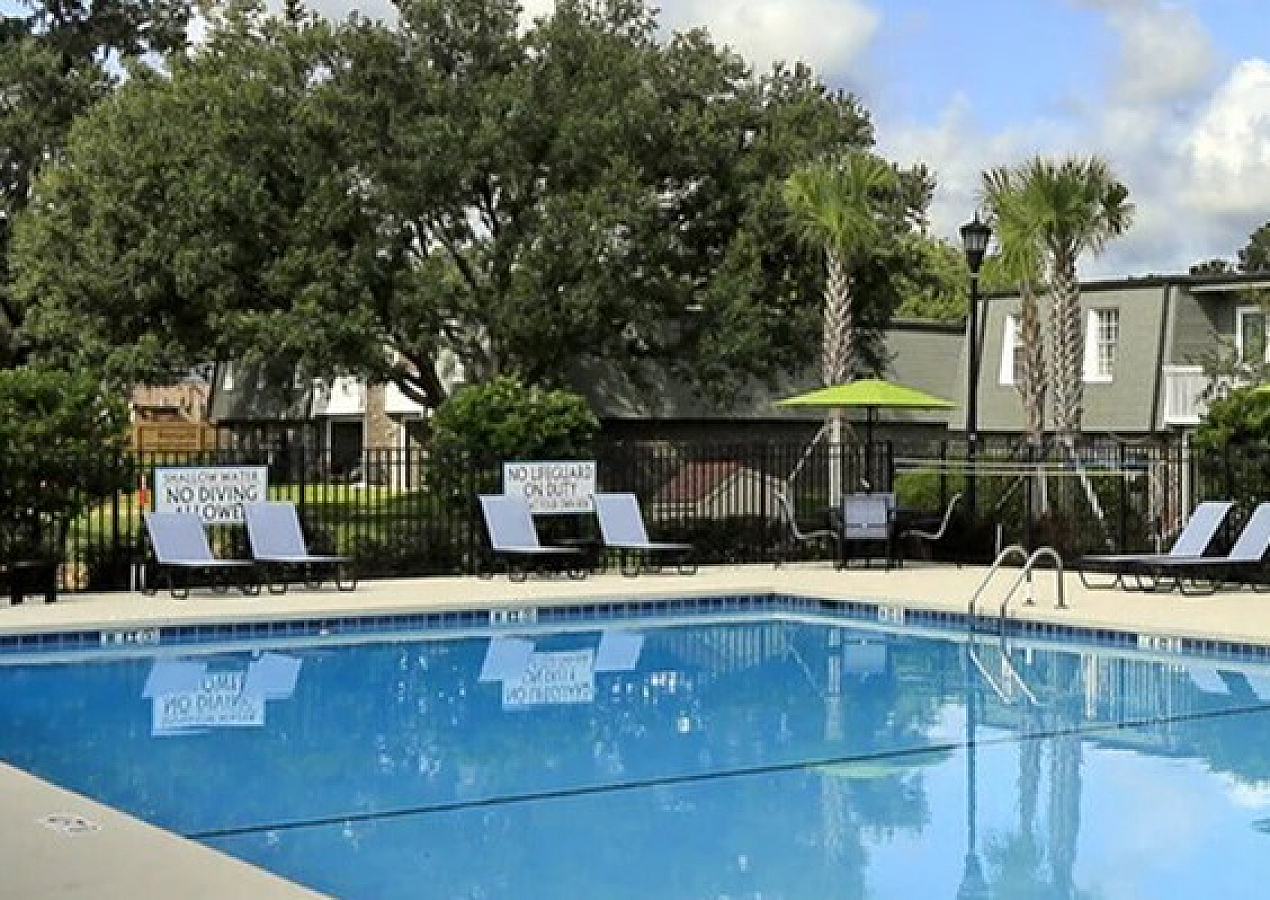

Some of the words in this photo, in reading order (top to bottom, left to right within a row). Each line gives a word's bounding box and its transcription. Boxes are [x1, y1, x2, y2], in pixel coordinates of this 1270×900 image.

[164, 471, 218, 483] SHALLOW
[221, 470, 258, 482] WATER
[508, 466, 528, 481] NO
[531, 464, 592, 480] LIFEGUARD
[166, 486, 194, 503] NO
[199, 485, 258, 503] DIVING
[524, 482, 543, 497] ON
[547, 481, 576, 496] DUTY
